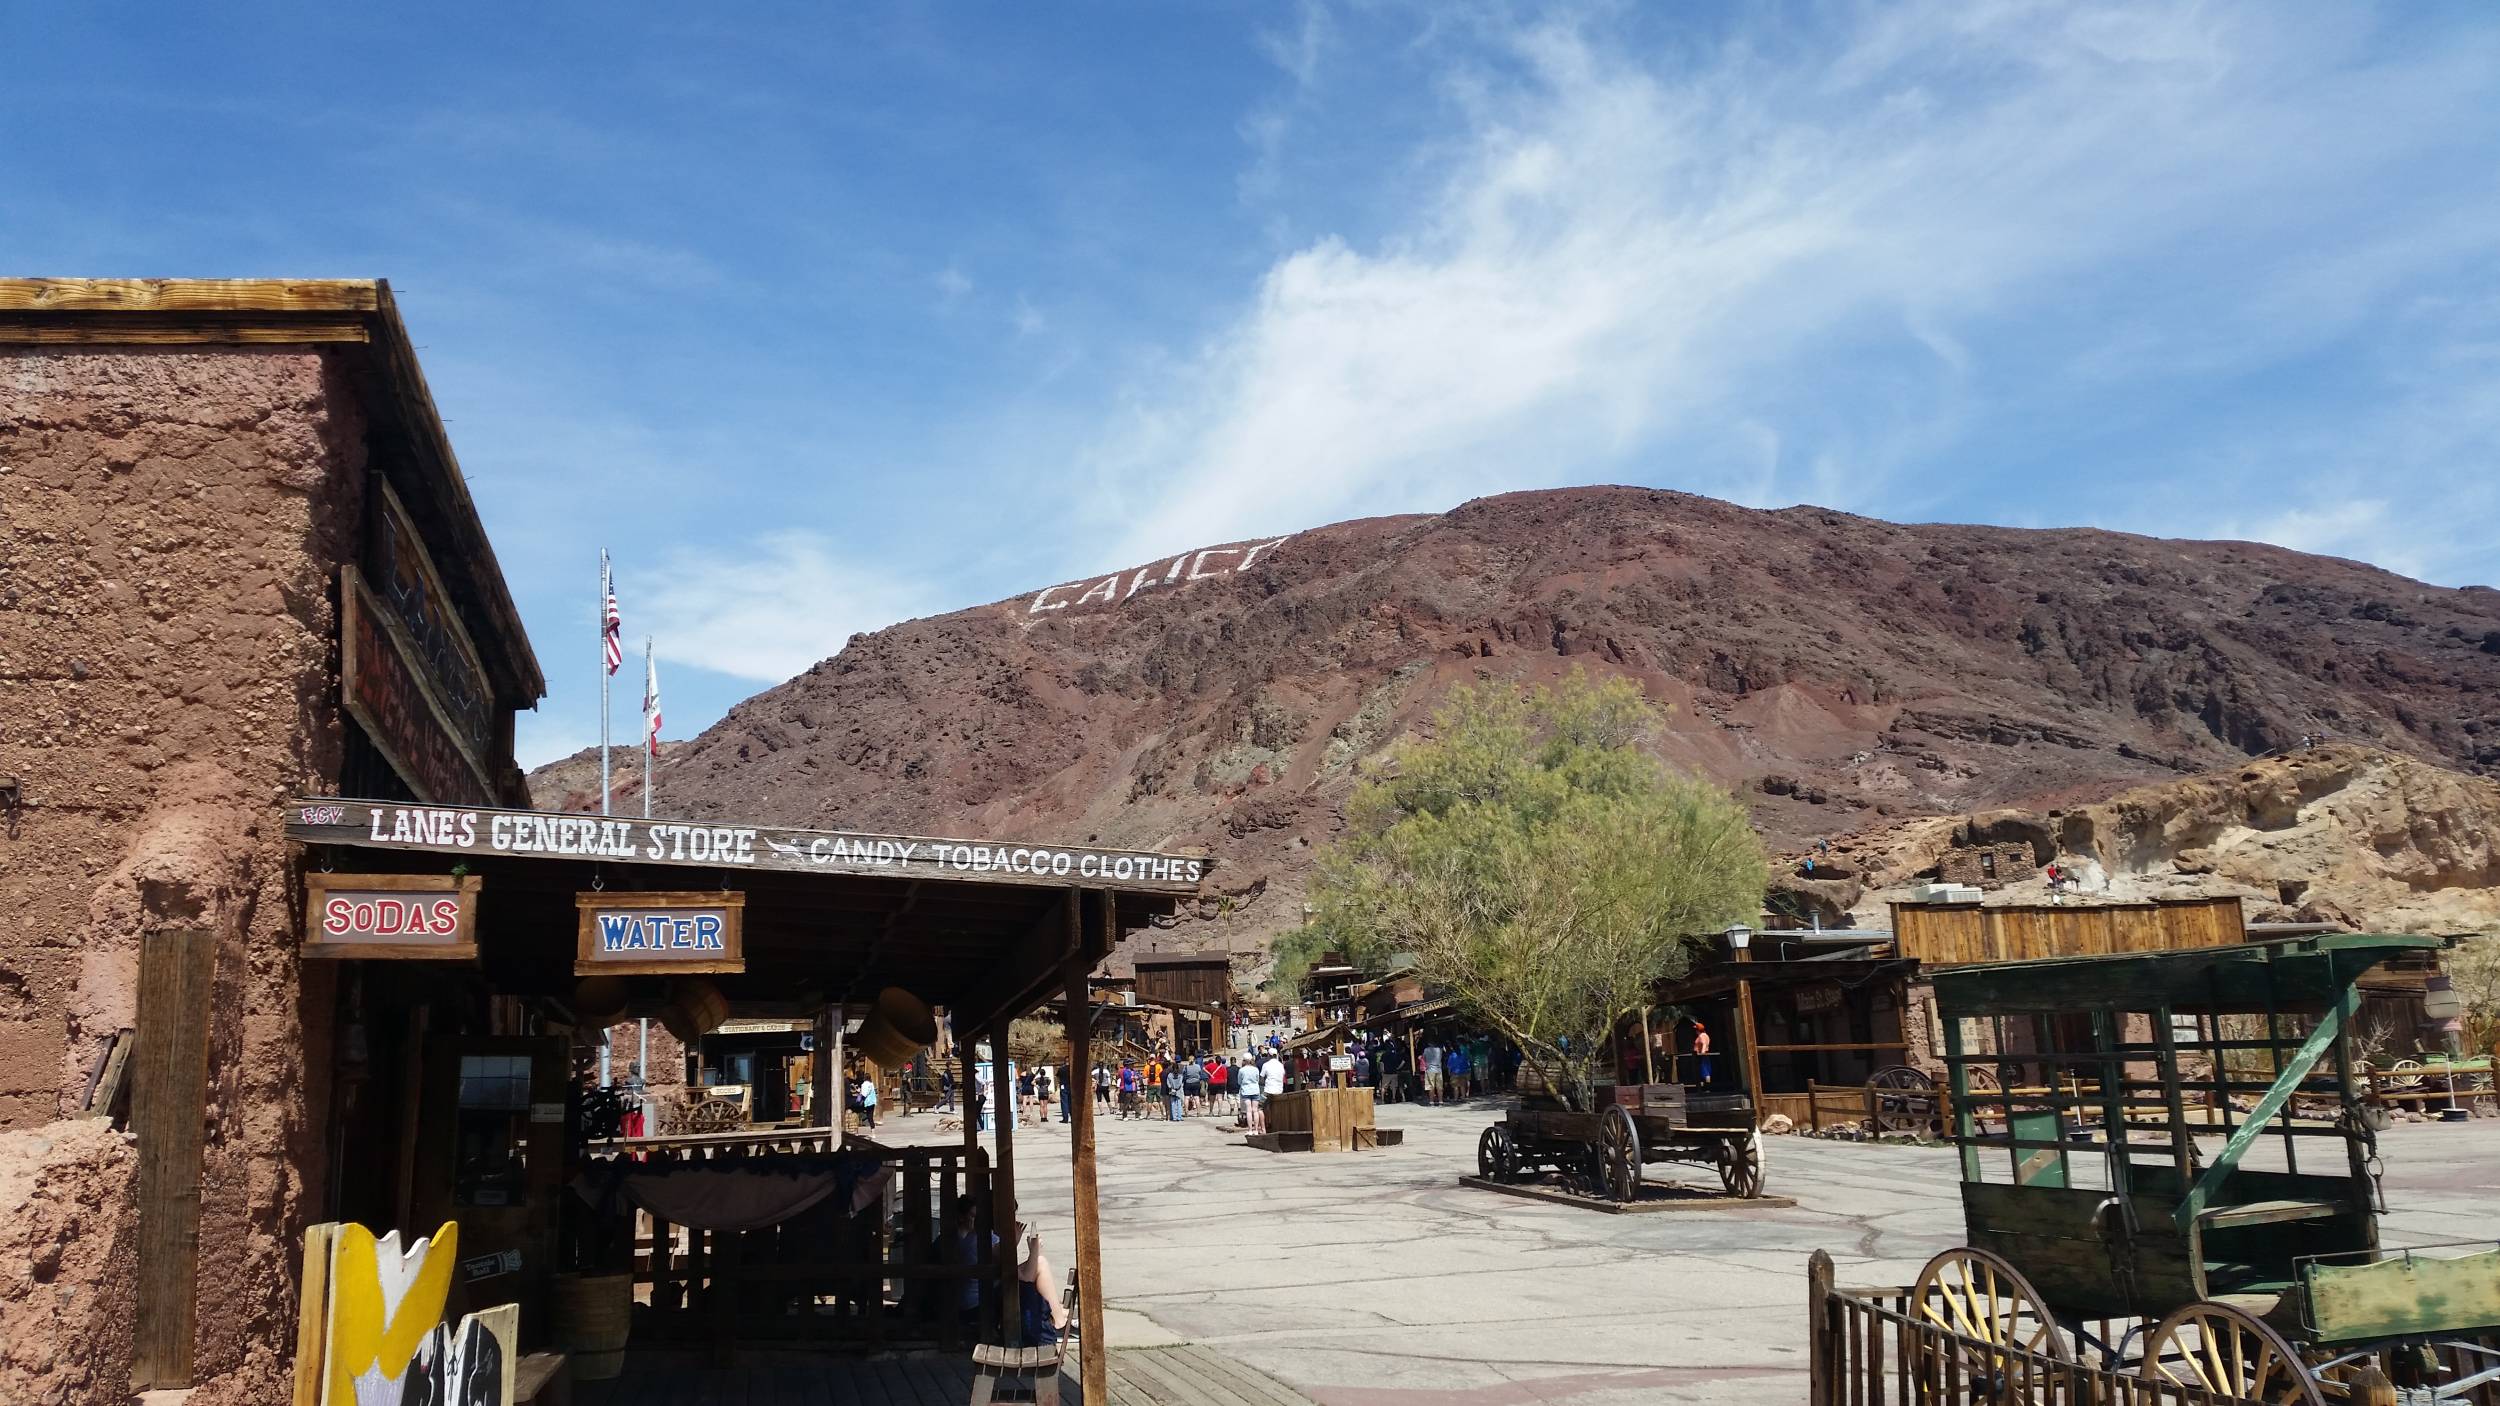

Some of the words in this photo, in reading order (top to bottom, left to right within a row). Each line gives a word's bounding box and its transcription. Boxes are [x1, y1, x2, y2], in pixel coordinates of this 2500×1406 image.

[301, 807, 344, 825] ECV
[370, 808, 477, 848] LANE'S
[491, 815, 637, 857] GENERAL
[646, 825, 757, 863] STORE
[810, 838, 918, 868] CANDY
[931, 844, 1070, 876] TOBACCO
[1080, 855, 1200, 882] CLOTHES
[322, 898, 460, 936] SODAS
[599, 914, 724, 951] WATER
